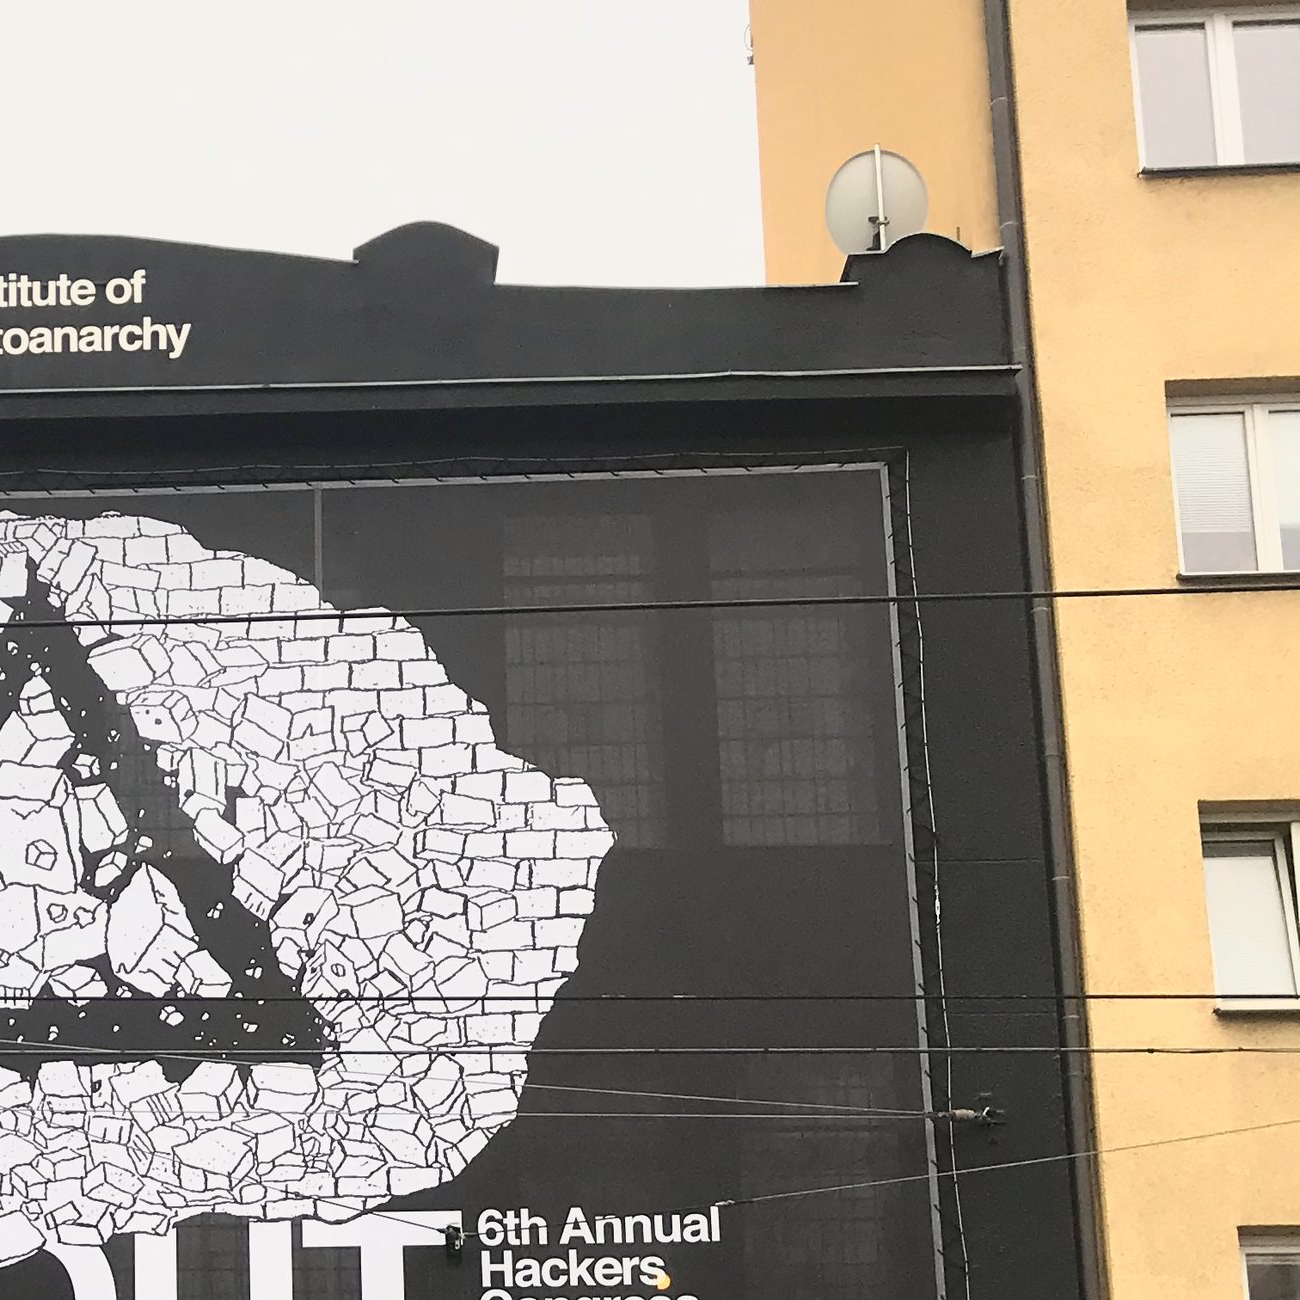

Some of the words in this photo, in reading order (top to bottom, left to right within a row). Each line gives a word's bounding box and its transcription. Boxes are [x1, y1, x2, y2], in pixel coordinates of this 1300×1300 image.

[105, 269, 146, 304] of
[477, 1207, 549, 1247] 6th
[558, 1205, 723, 1246] Annual
[480, 1249, 667, 1289] Hackers
